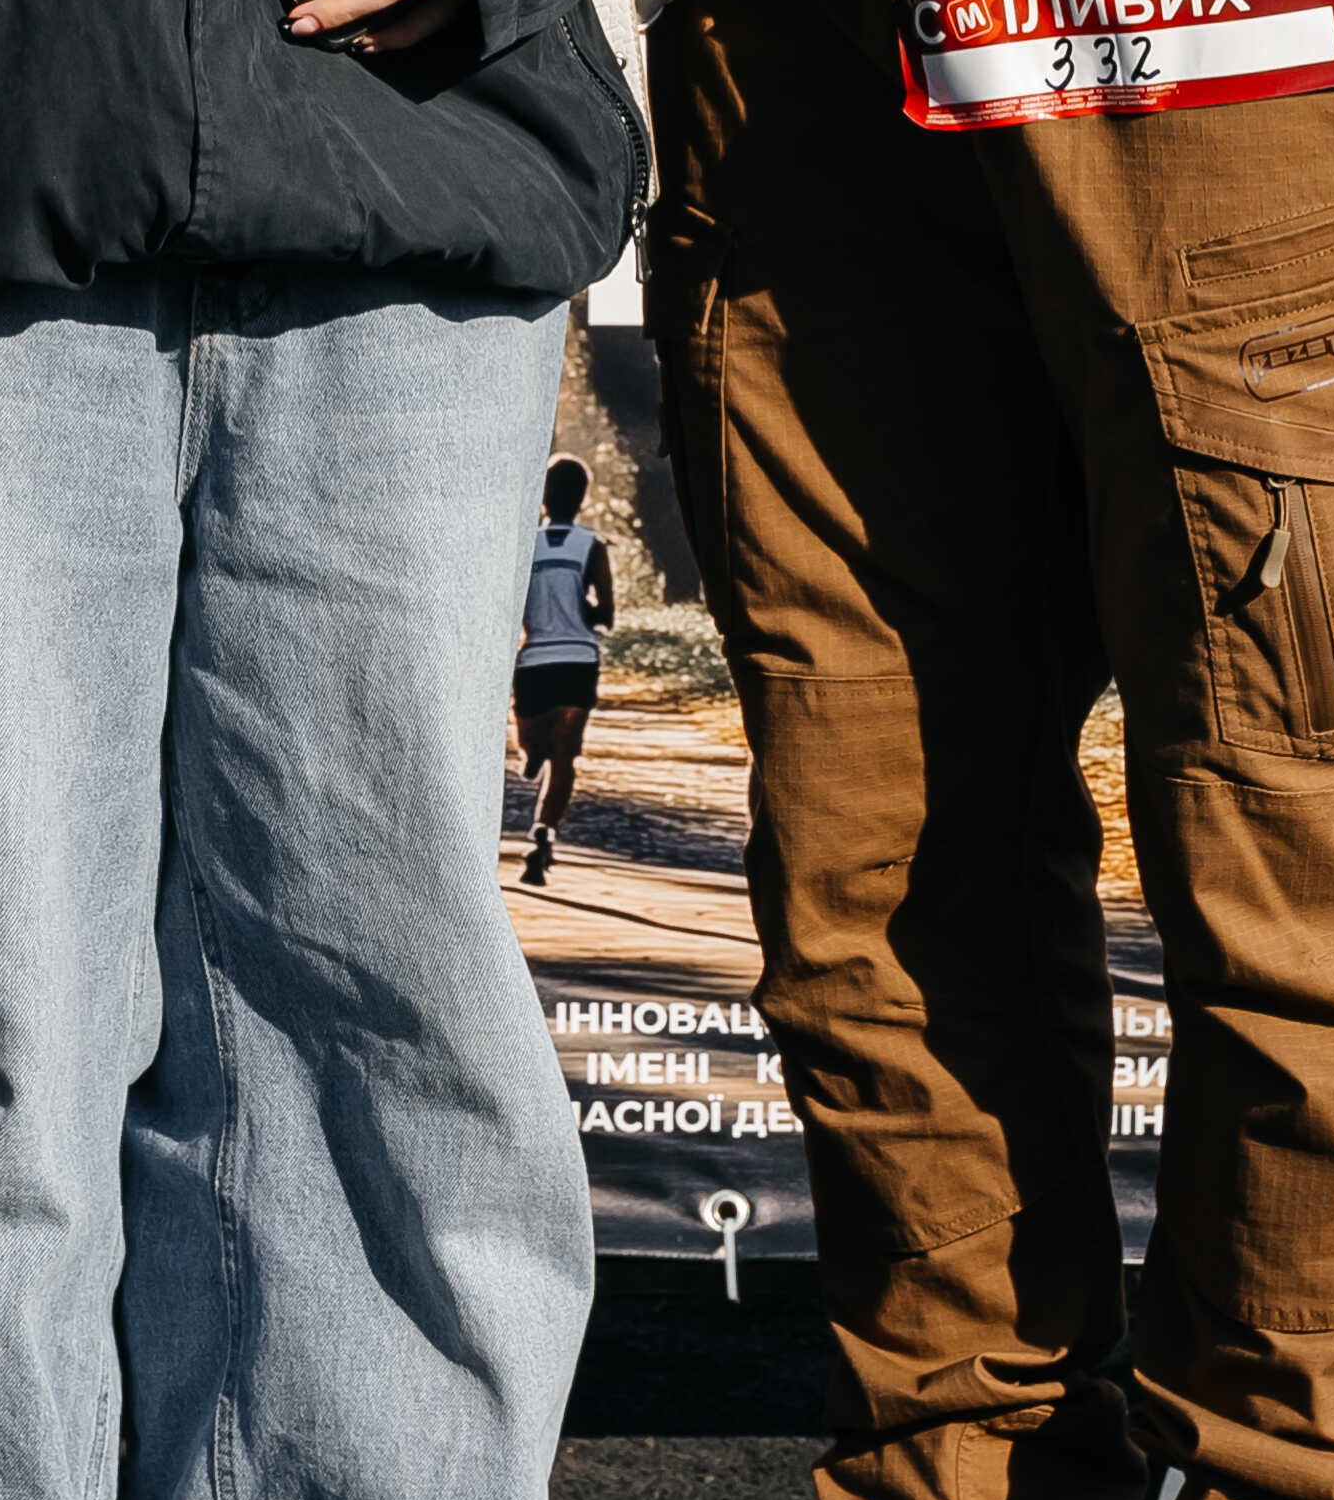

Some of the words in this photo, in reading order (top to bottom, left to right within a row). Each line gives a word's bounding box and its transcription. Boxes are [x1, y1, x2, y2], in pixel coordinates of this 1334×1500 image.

[555, 1001, 771, 1040] ІННОВАЦ
[586, 1052, 710, 1085] ІМЕНІ
[732, 1101, 804, 1139] ДЕ
